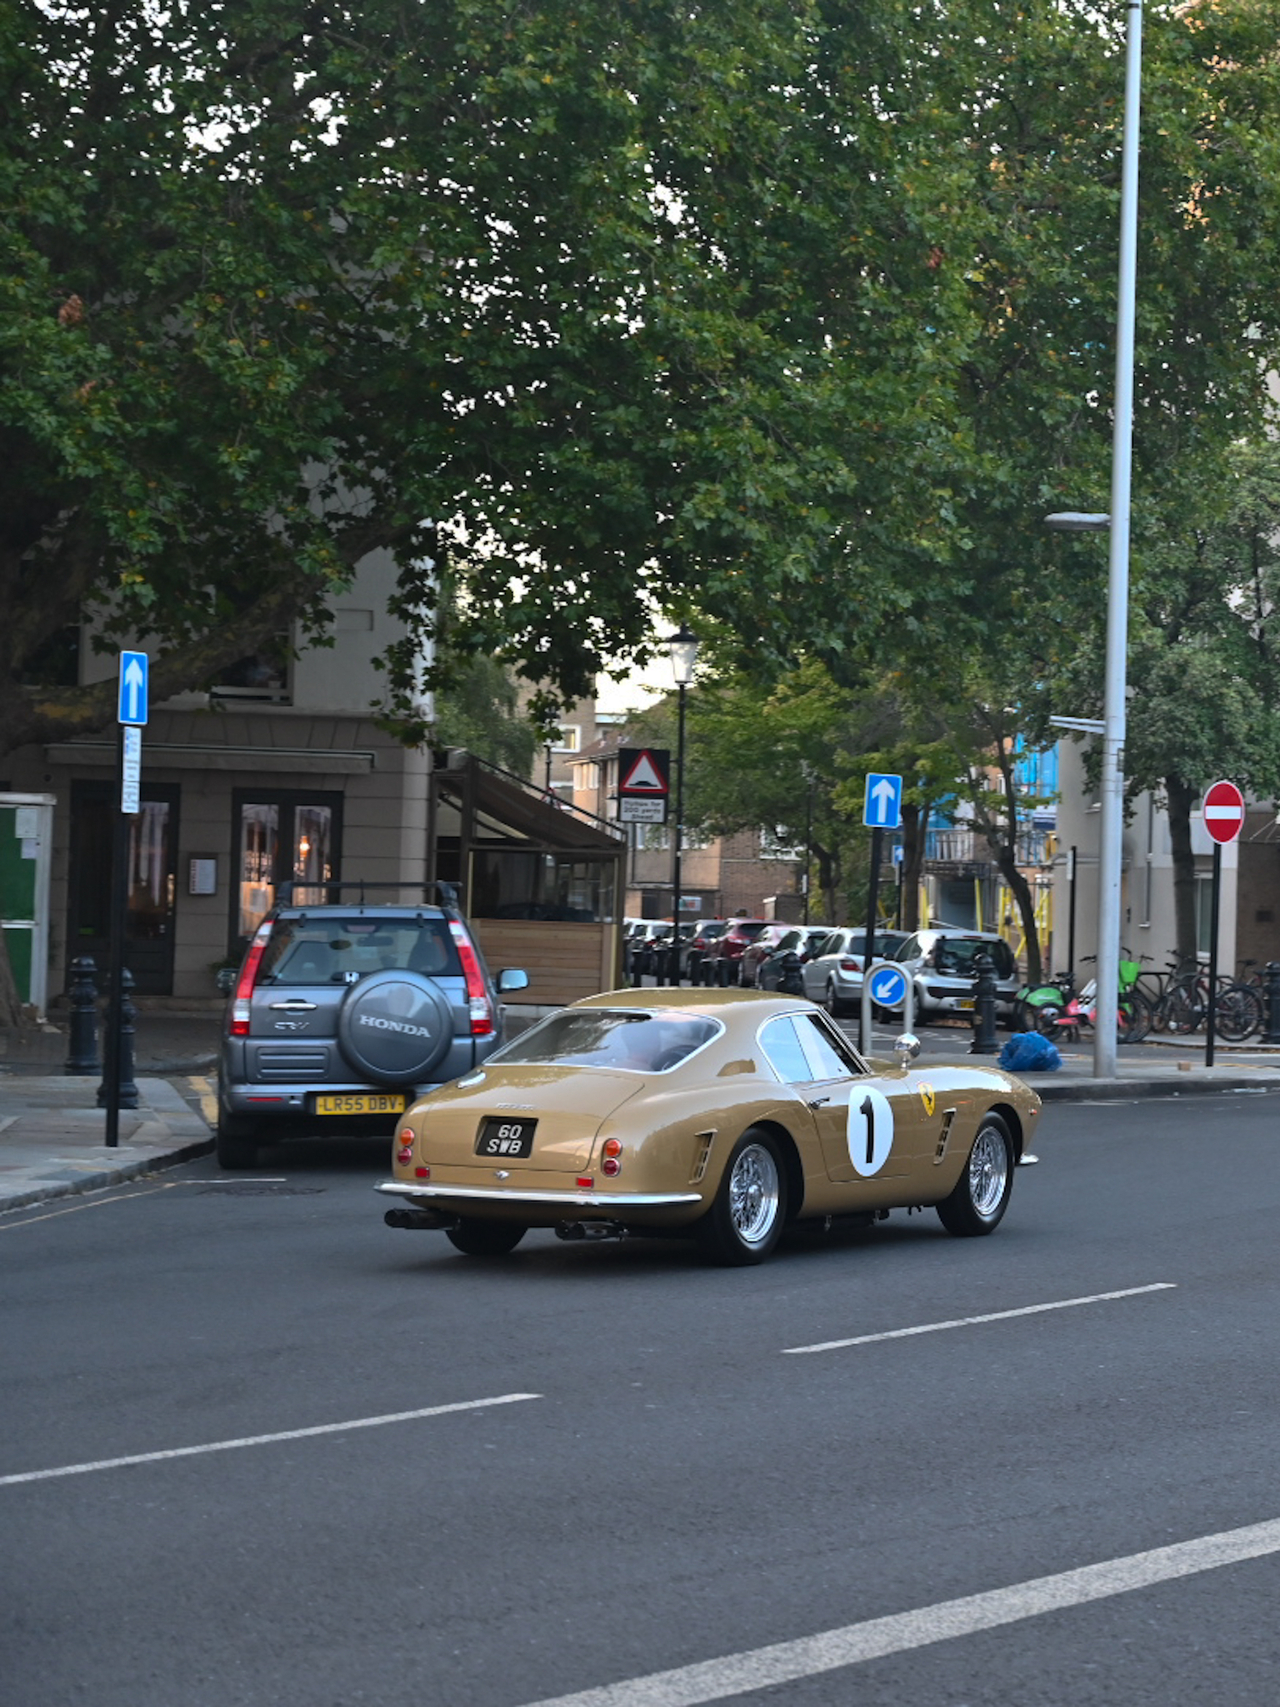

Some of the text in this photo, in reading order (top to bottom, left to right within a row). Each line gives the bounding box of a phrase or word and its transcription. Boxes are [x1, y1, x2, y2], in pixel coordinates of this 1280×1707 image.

[359, 1014, 431, 1039] HONDA
[323, 1097, 364, 1112] LR55
[497, 1124, 523, 1139] 60
[859, 1095, 875, 1164] 1
[486, 1138, 523, 1154] SWB
